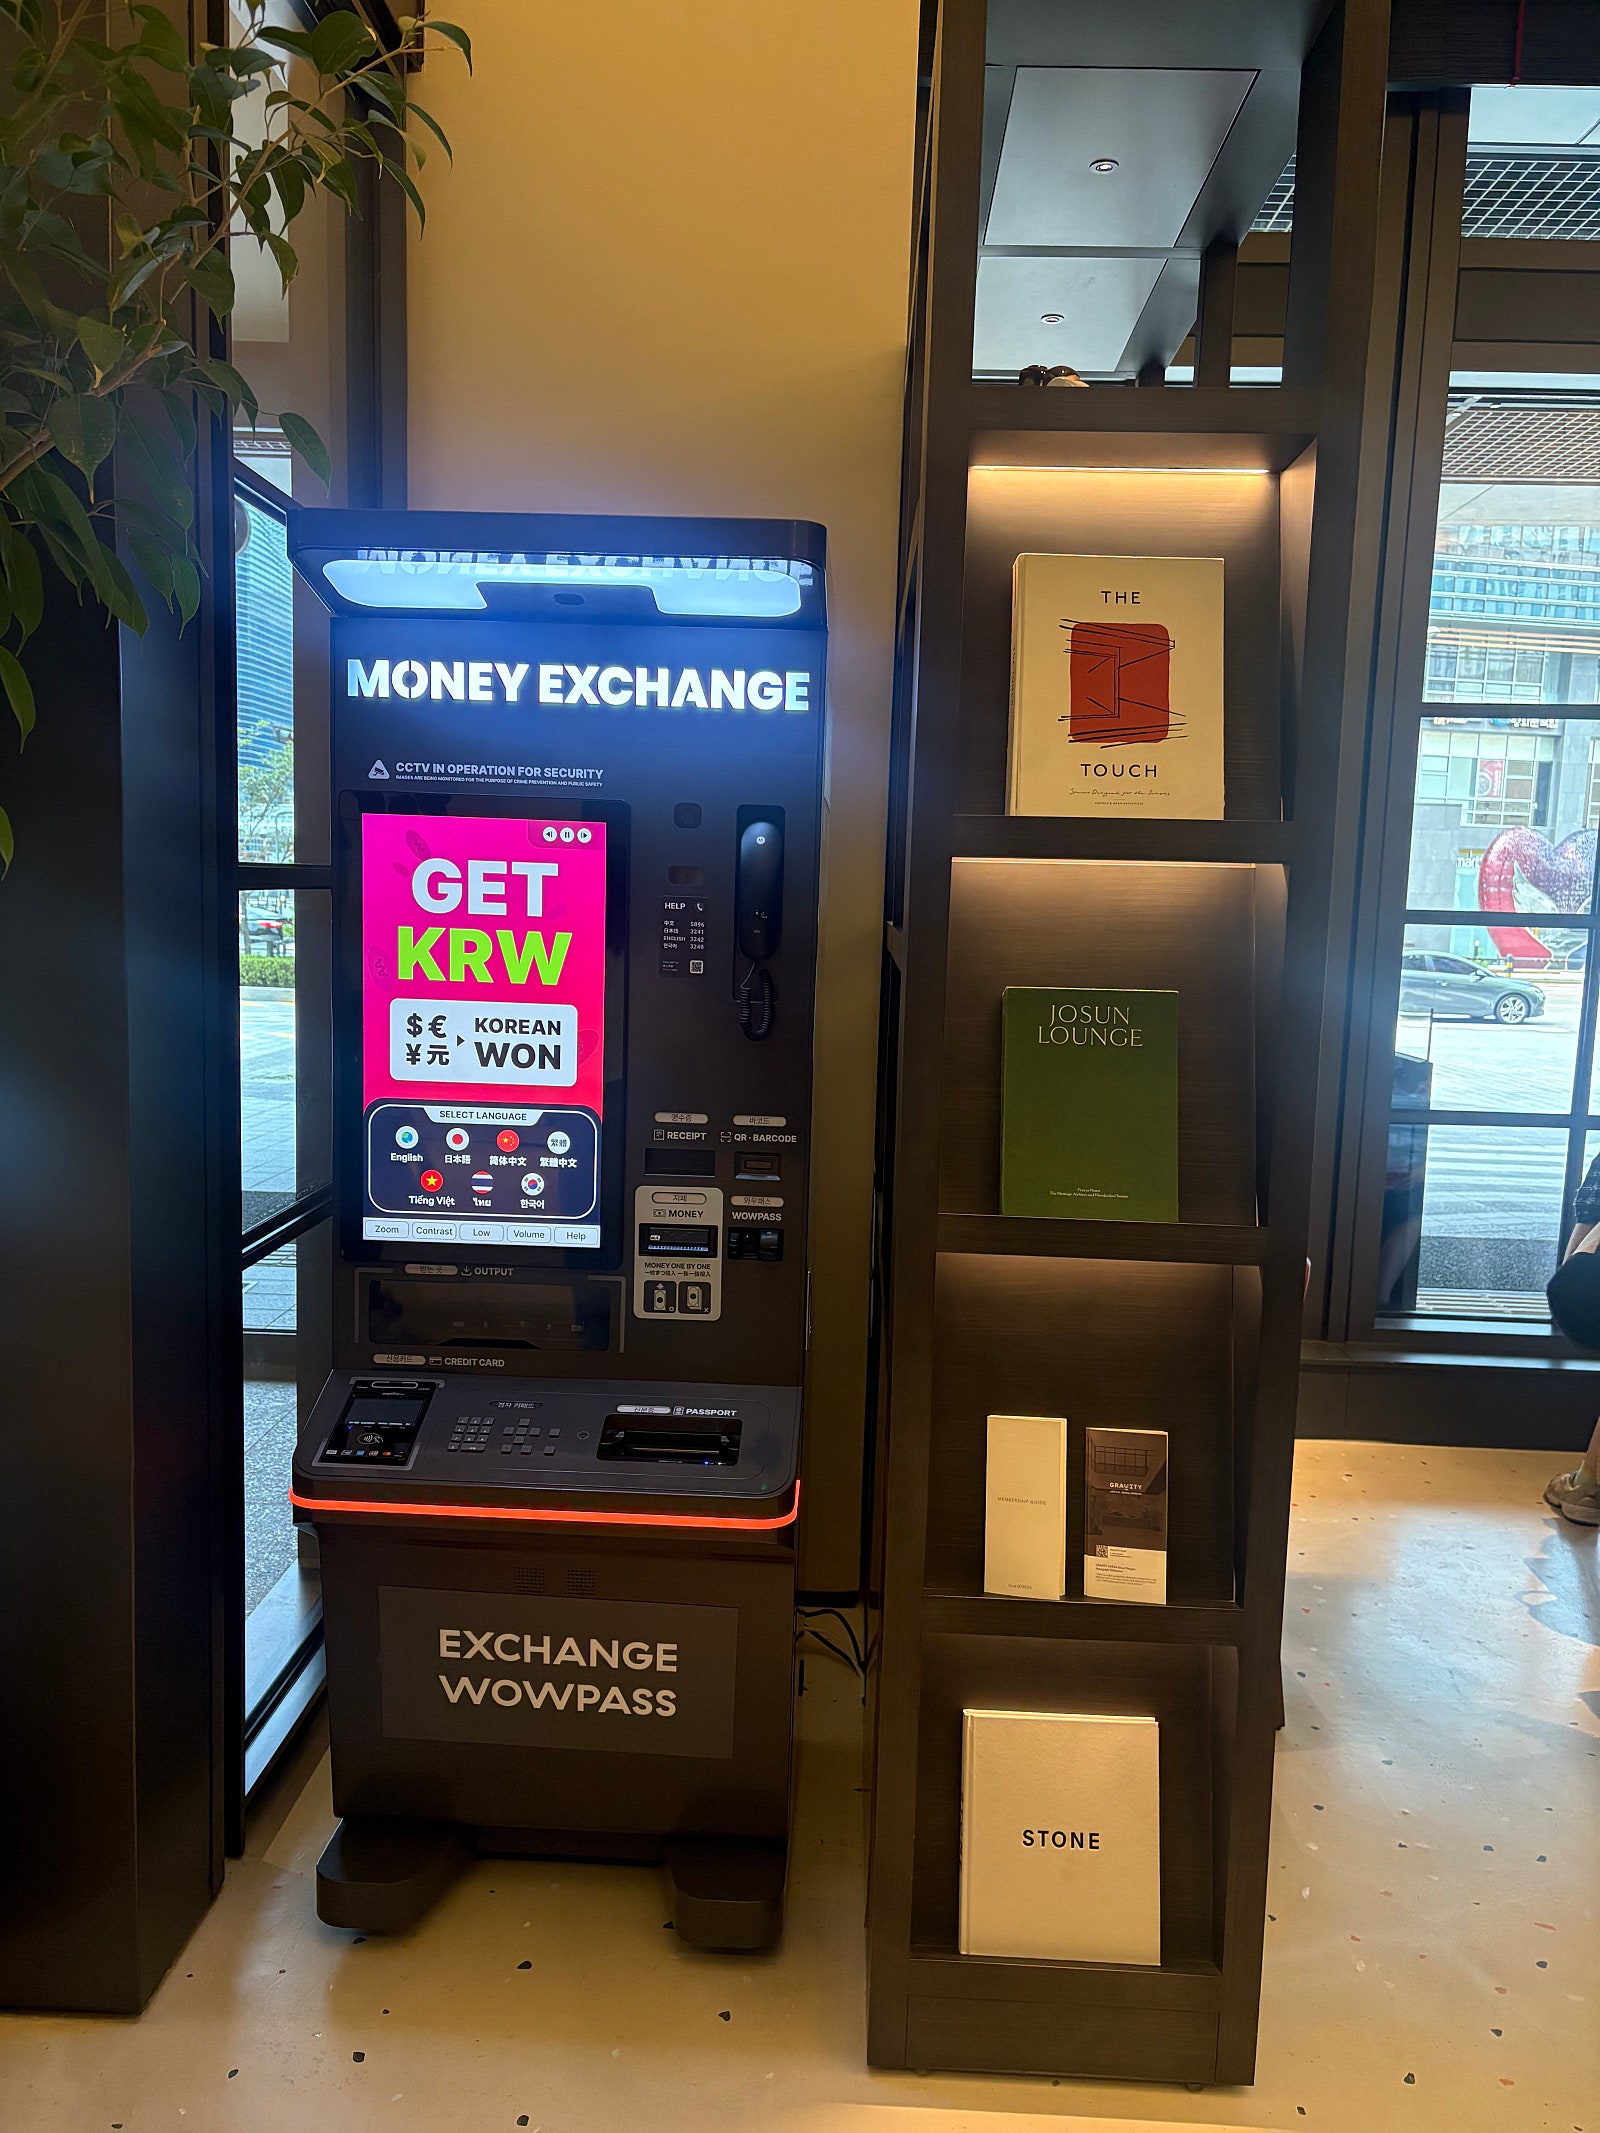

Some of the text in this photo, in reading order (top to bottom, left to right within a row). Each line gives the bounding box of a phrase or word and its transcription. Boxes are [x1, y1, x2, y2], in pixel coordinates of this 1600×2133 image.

[1101, 591, 1141, 605] THE
[347, 659, 810, 711] MONEY EXCHANGE
[396, 762, 603, 780] CCTV IN OPERATION FOR SECURITY
[1080, 763, 1157, 778] TOUCH
[412, 858, 558, 917] GET
[664, 902, 686, 910] HELP
[398, 926, 572, 986] KRW
[1049, 1004, 1130, 1027] JOSUN
[474, 1017, 561, 1036] KOREAN
[1038, 1026, 1143, 1047] LOUNGE
[474, 1042, 561, 1070] WON
[439, 1110, 527, 1122] SELECT LANGUAGE
[667, 1131, 707, 1141] RECEIPT
[390, 1152, 424, 1164] English
[444, 1154, 471, 1165] 日本語
[489, 1156, 527, 1167] 简体中文
[408, 1194, 456, 1208] Tiếng Việt
[472, 1197, 492, 1208] ไทย
[520, 1199, 545, 1210] 한국어
[668, 1209, 704, 1219] MONEY
[731, 1211, 782, 1221] WOWPASS
[374, 1224, 399, 1234] Zoom
[416, 1226, 453, 1236] Contrast
[473, 1229, 491, 1238] Low
[513, 1230, 545, 1240] Volume
[566, 1232, 586, 1242] Help
[474, 1267, 514, 1276] OUTPUT
[644, 1262, 670, 1270] MONEY
[671, 1262, 686, 1270] ONE
[697, 1263, 711, 1271] ONE
[444, 1357, 505, 1368] CREDIT CARD
[685, 1408, 738, 1417] PASSPORT
[438, 1629, 678, 1673] EXCHANGE
[438, 1675, 677, 1717] WOWPASS
[1022, 1829, 1100, 1850] STONE
